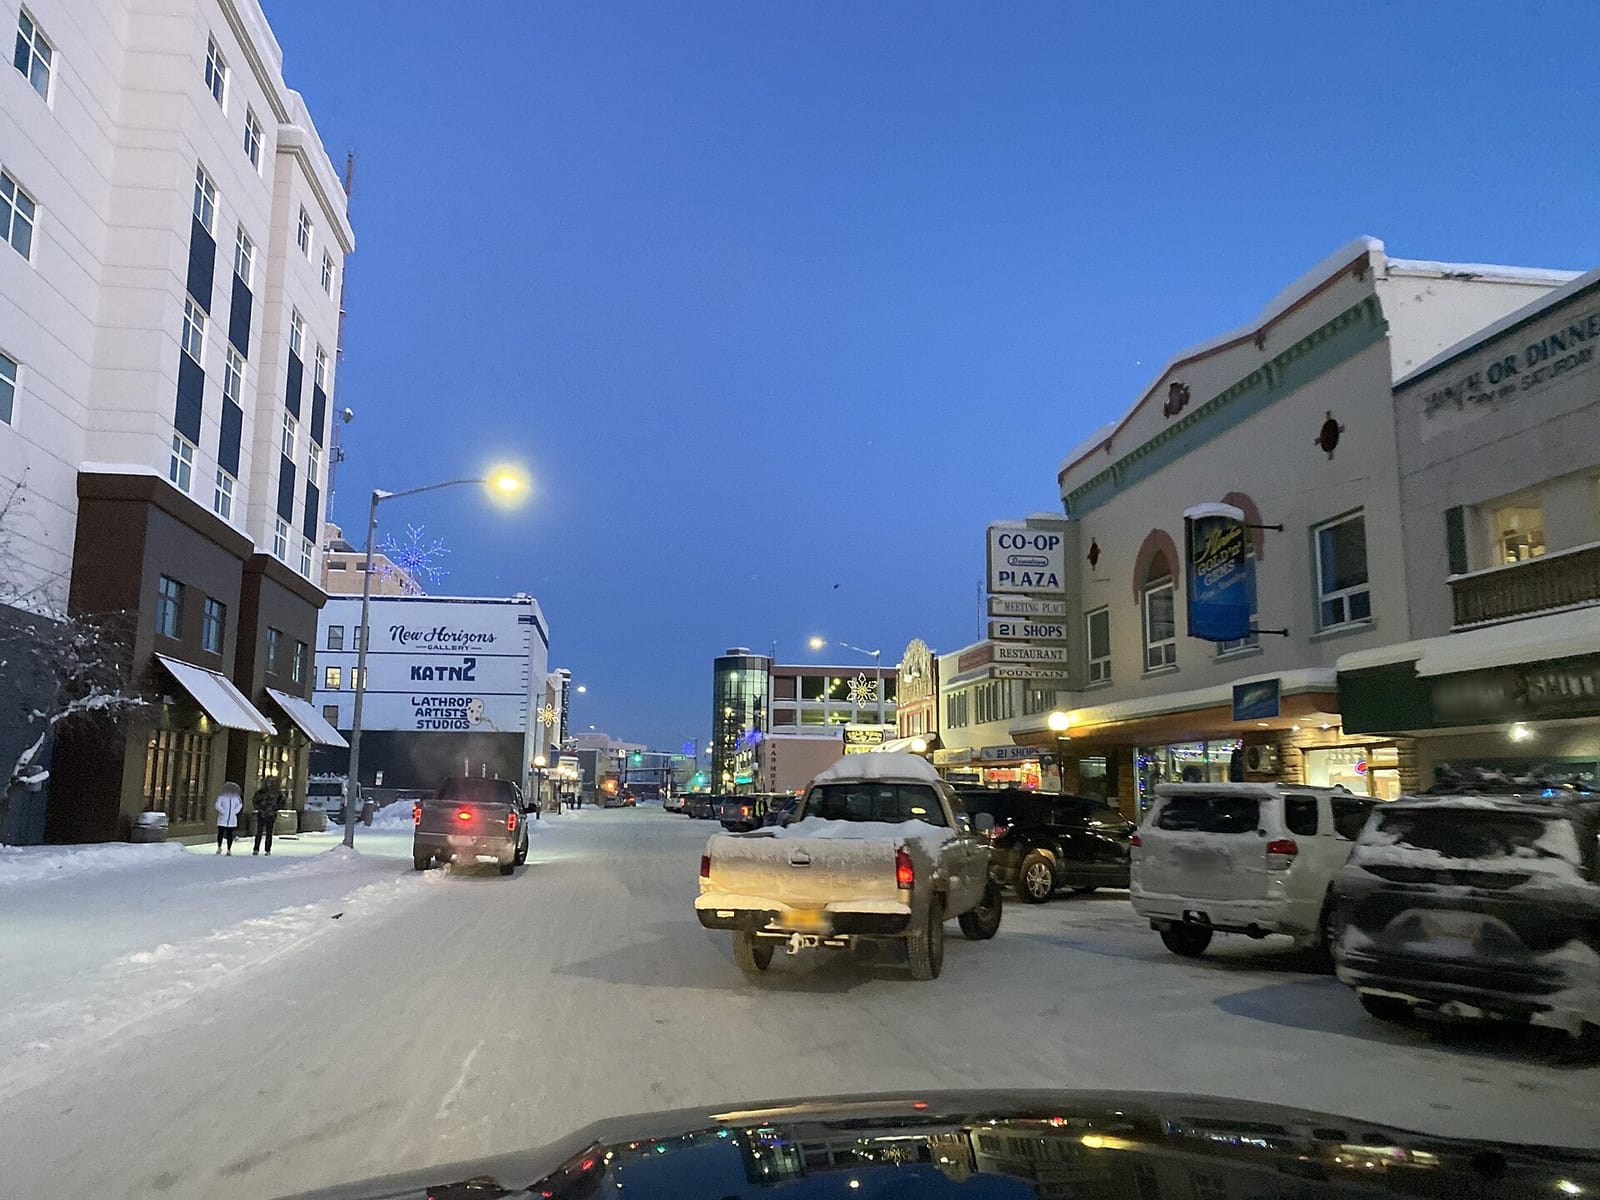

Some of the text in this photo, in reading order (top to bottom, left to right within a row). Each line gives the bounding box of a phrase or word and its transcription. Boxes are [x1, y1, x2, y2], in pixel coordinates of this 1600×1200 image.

[998, 533, 1060, 551] CO-OP
[998, 570, 1060, 588] PLAZA
[1005, 601, 1039, 613] MEETING
[389, 625, 497, 646] New Horizons
[1000, 624, 1063, 637] 21 SHOPS
[999, 648, 1064, 660] RESTAURANT
[998, 669, 1064, 678] FOUNTAIN
[411, 696, 473, 707] LATHROP
[414, 707, 468, 718] ARTISTS
[416, 719, 470, 729] STUDIOS
[996, 749, 1007, 758] 21
